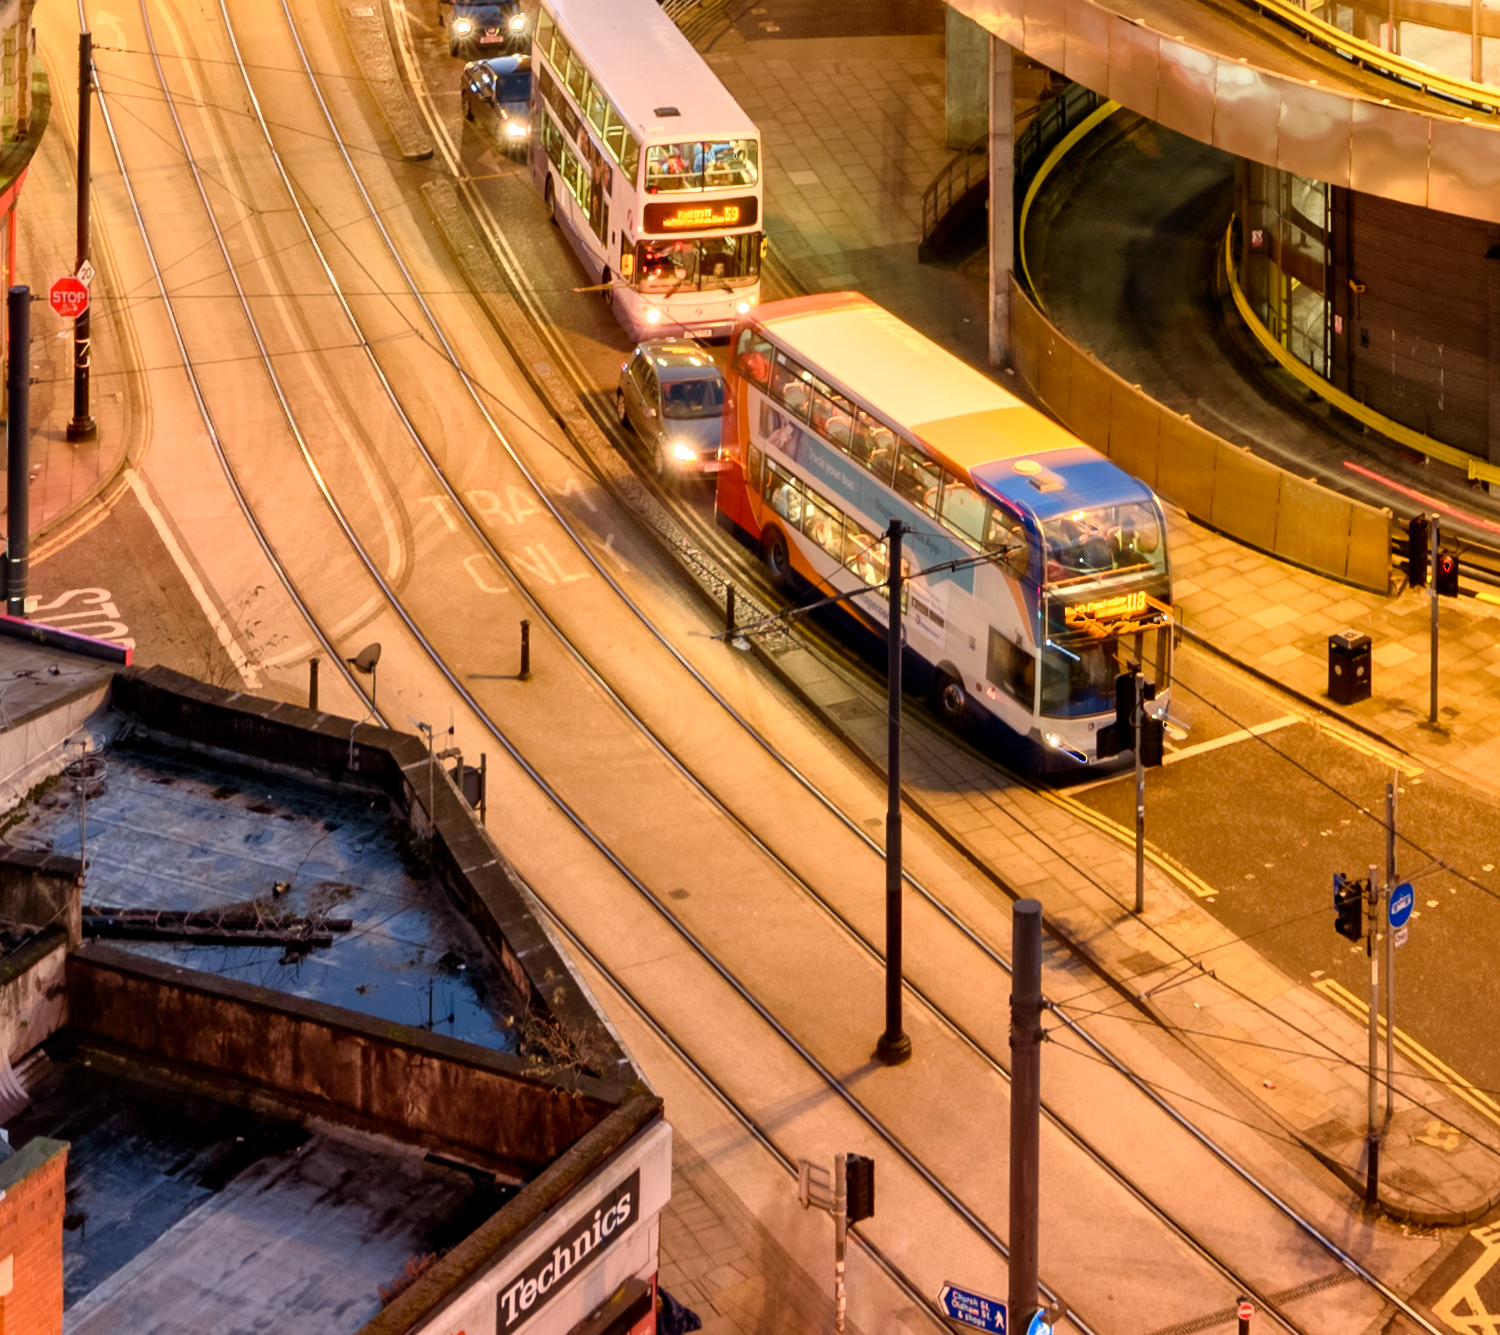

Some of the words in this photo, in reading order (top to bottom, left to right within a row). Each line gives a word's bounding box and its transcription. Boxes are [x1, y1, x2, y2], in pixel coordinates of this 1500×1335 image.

[81, 266, 92, 280] 20
[52, 290, 86, 304] STOP
[417, 476, 599, 533] TRAM
[1127, 590, 1147, 612] 118
[501, 1192, 631, 1327] Technics
[952, 1290, 979, 1307] Church
[951, 1299, 979, 1316] Oldham
[964, 1313, 986, 1328] shops
